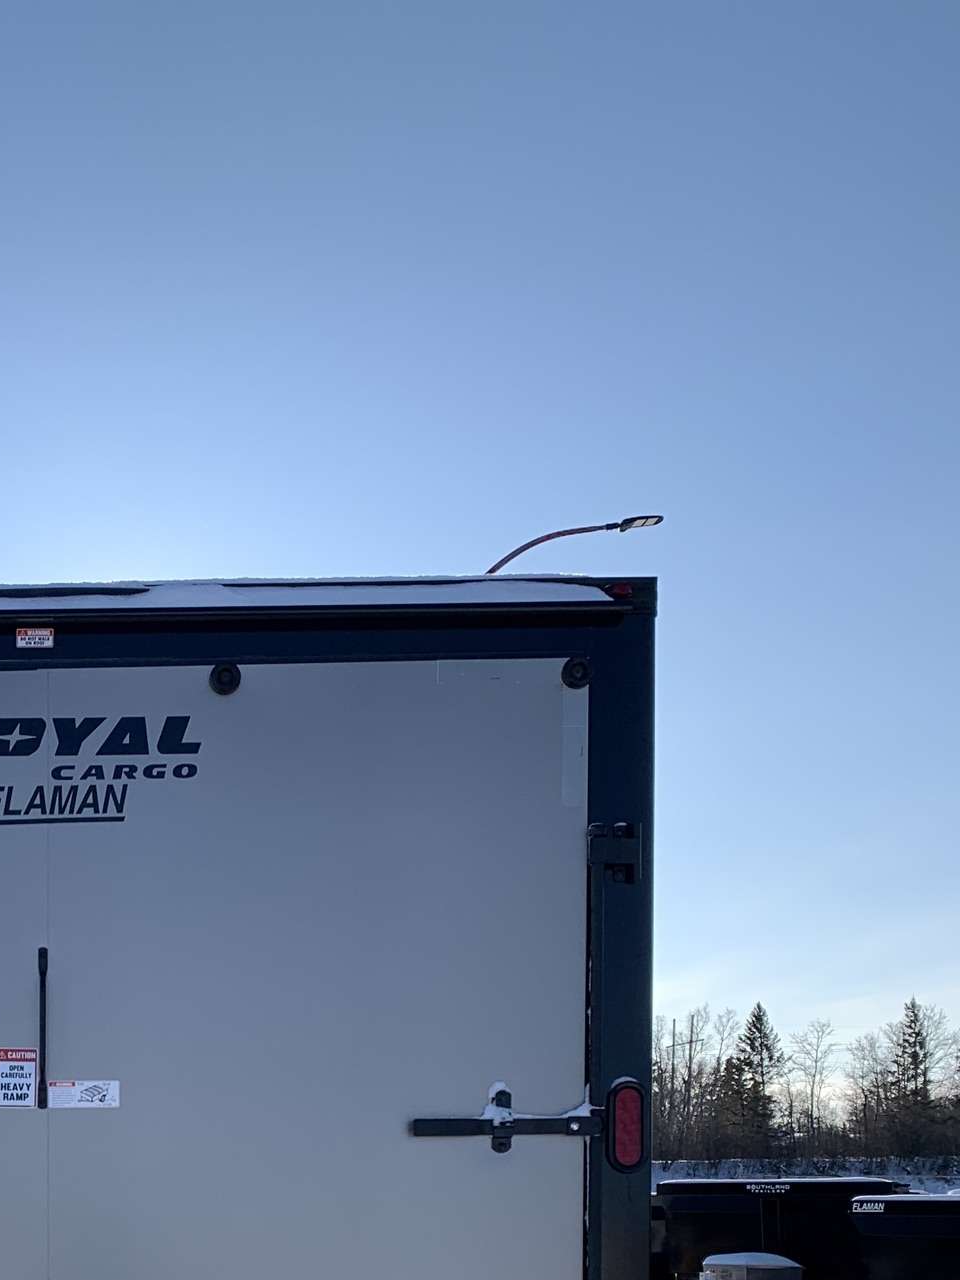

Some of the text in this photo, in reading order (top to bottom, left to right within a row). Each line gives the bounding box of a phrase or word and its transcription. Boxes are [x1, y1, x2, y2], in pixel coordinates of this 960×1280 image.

[51, 763, 198, 780] CARGO
[7, 1051, 36, 1059] CAUTION
[0, 1083, 32, 1091] HEAVY
[3, 1093, 29, 1101] RAMP
[852, 1202, 885, 1210] FLAMAN
